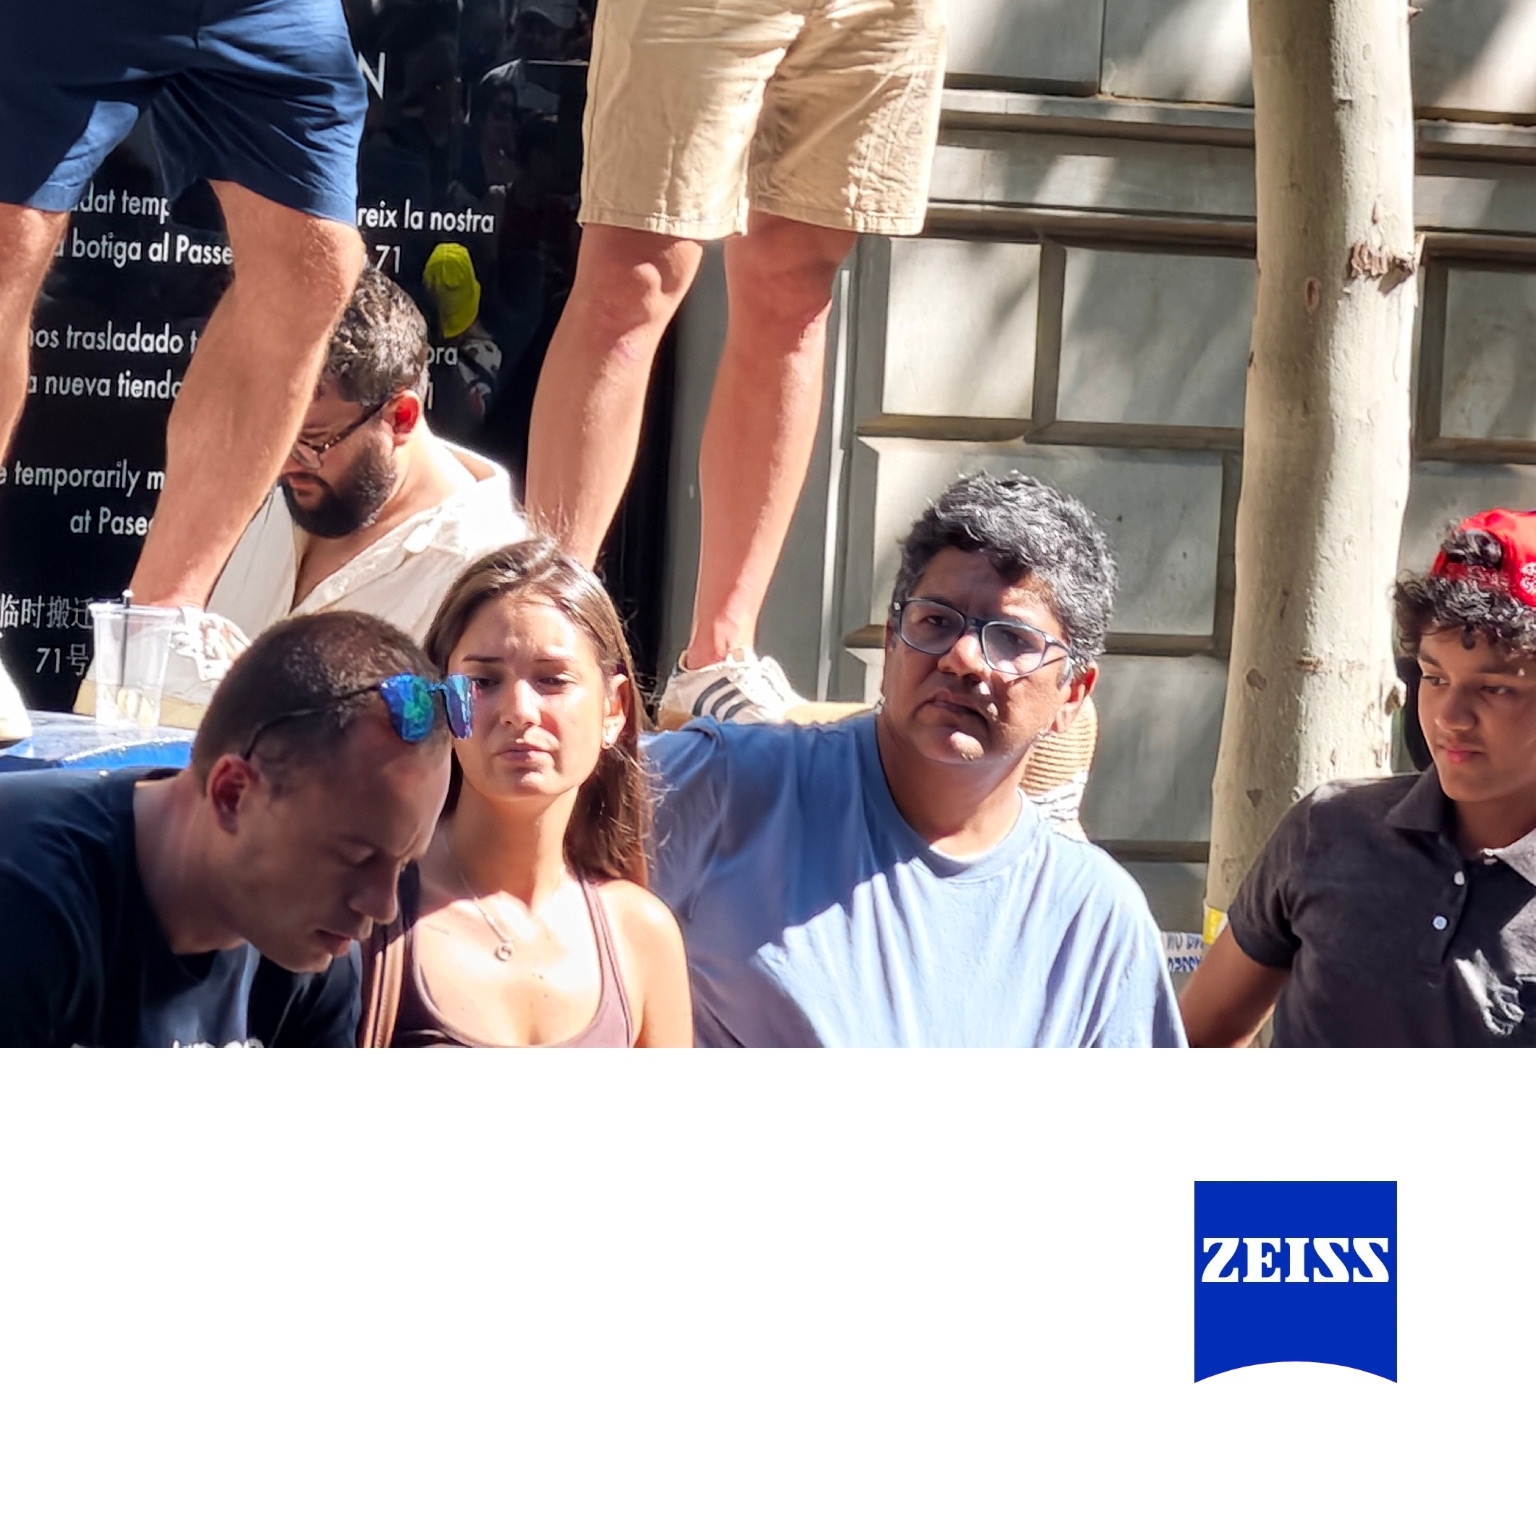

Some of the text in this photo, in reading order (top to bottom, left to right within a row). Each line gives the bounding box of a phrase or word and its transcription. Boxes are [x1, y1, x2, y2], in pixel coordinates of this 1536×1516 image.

[70, 188, 115, 213] dat
[404, 199, 423, 231] la
[430, 206, 494, 233] nostra
[72, 228, 141, 267] botiga
[148, 232, 168, 262] al
[375, 245, 401, 273] 71
[30, 327, 60, 348] os
[66, 320, 184, 354] trasladado
[45, 375, 111, 397] nueva
[14, 458, 140, 497] temporarily
[70, 506, 153, 536] at Pase
[35, 643, 89, 676] 71号
